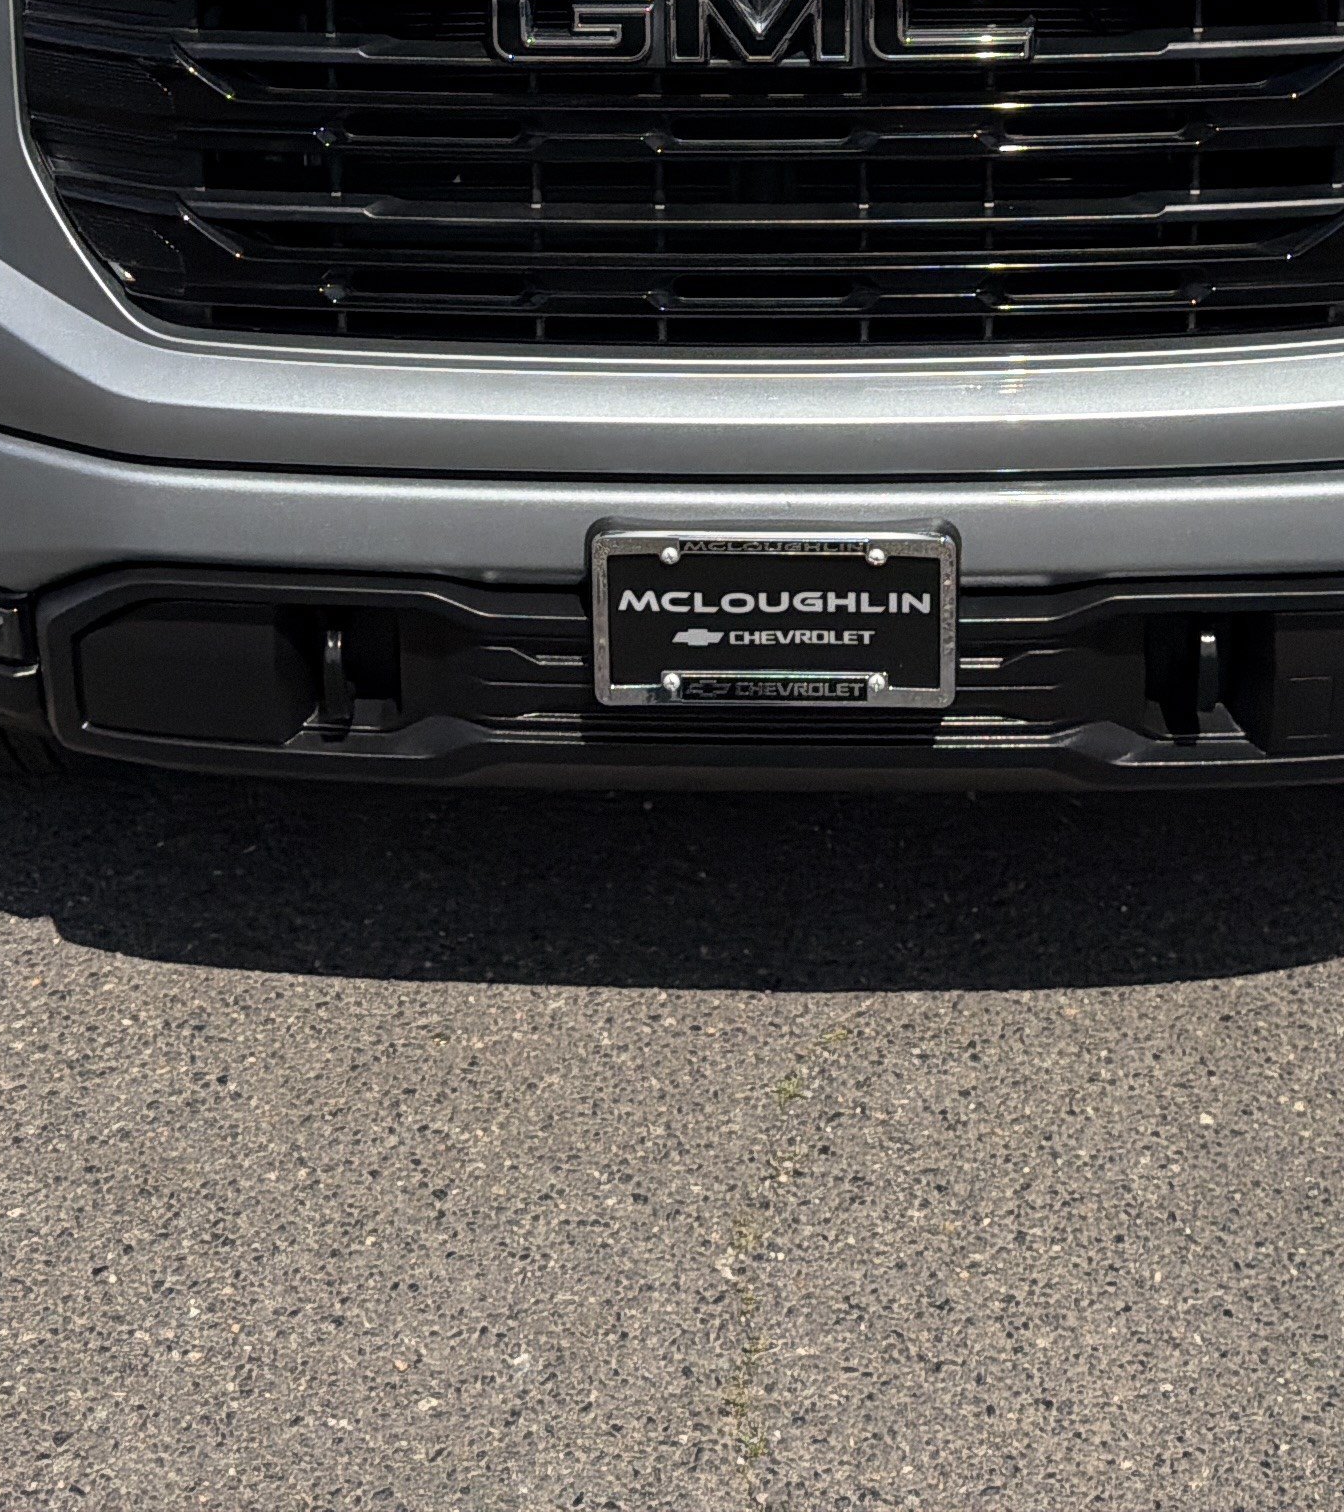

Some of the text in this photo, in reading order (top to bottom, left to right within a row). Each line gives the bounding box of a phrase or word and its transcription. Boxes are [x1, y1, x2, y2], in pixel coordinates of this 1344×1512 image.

[684, 541, 863, 552] MCLOUGHLIN
[618, 590, 931, 613] MCLOUGHLIN
[729, 630, 875, 645] CHEVROLET
[736, 682, 864, 696] CHEVROLET
